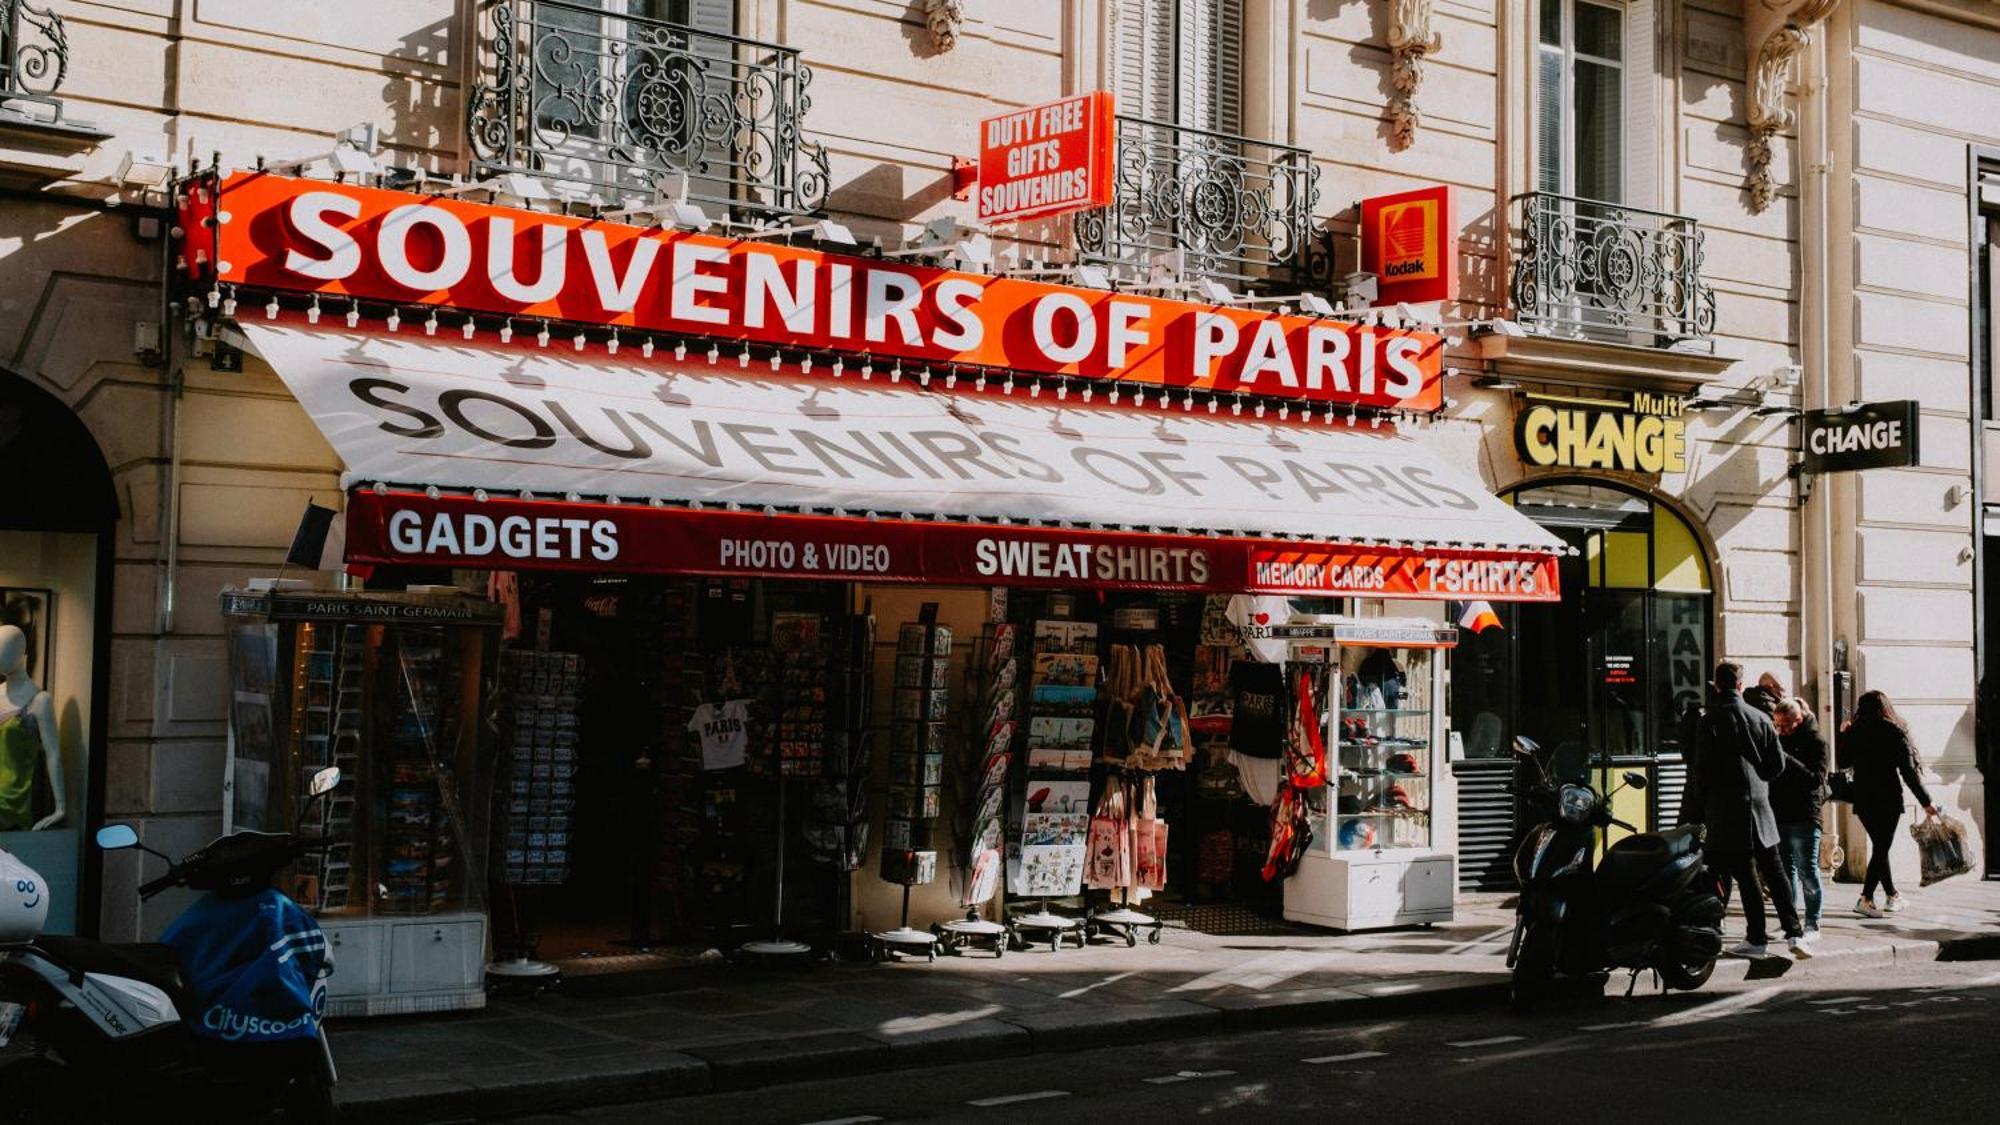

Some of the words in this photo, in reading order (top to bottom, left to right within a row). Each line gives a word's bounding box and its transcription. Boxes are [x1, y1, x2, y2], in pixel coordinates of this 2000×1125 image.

[988, 110, 1037, 149] DUTY
[1040, 99, 1084, 138] FREE
[1007, 138, 1061, 178] GIFTS
[981, 167, 1087, 216] SOUVENIRS
[1385, 259, 1425, 277] Kodak
[284, 190, 986, 352] SOUVENIRS
[1032, 292, 1151, 368] OF
[1194, 311, 1424, 399] PARIS
[1633, 391, 1683, 418] Multi
[349, 378, 1065, 484] SOUVENIRS
[1070, 446, 1208, 497] OF
[1216, 455, 1480, 511] PARIS
[1525, 406, 1687, 474] CHANGE
[1809, 420, 1902, 456] CHANGE
[389, 509, 620, 562] GADGETS
[720, 538, 796, 570] PHOTO
[802, 541, 819, 570] &
[825, 543, 890, 572] VIDEO
[1256, 561, 1326, 588] MEMORY
[1331, 564, 1385, 589] CARDS
[1424, 559, 1536, 593] T-SHIRTS
[306, 602, 349, 617] PARIS
[704, 718, 741, 737] PARIS
